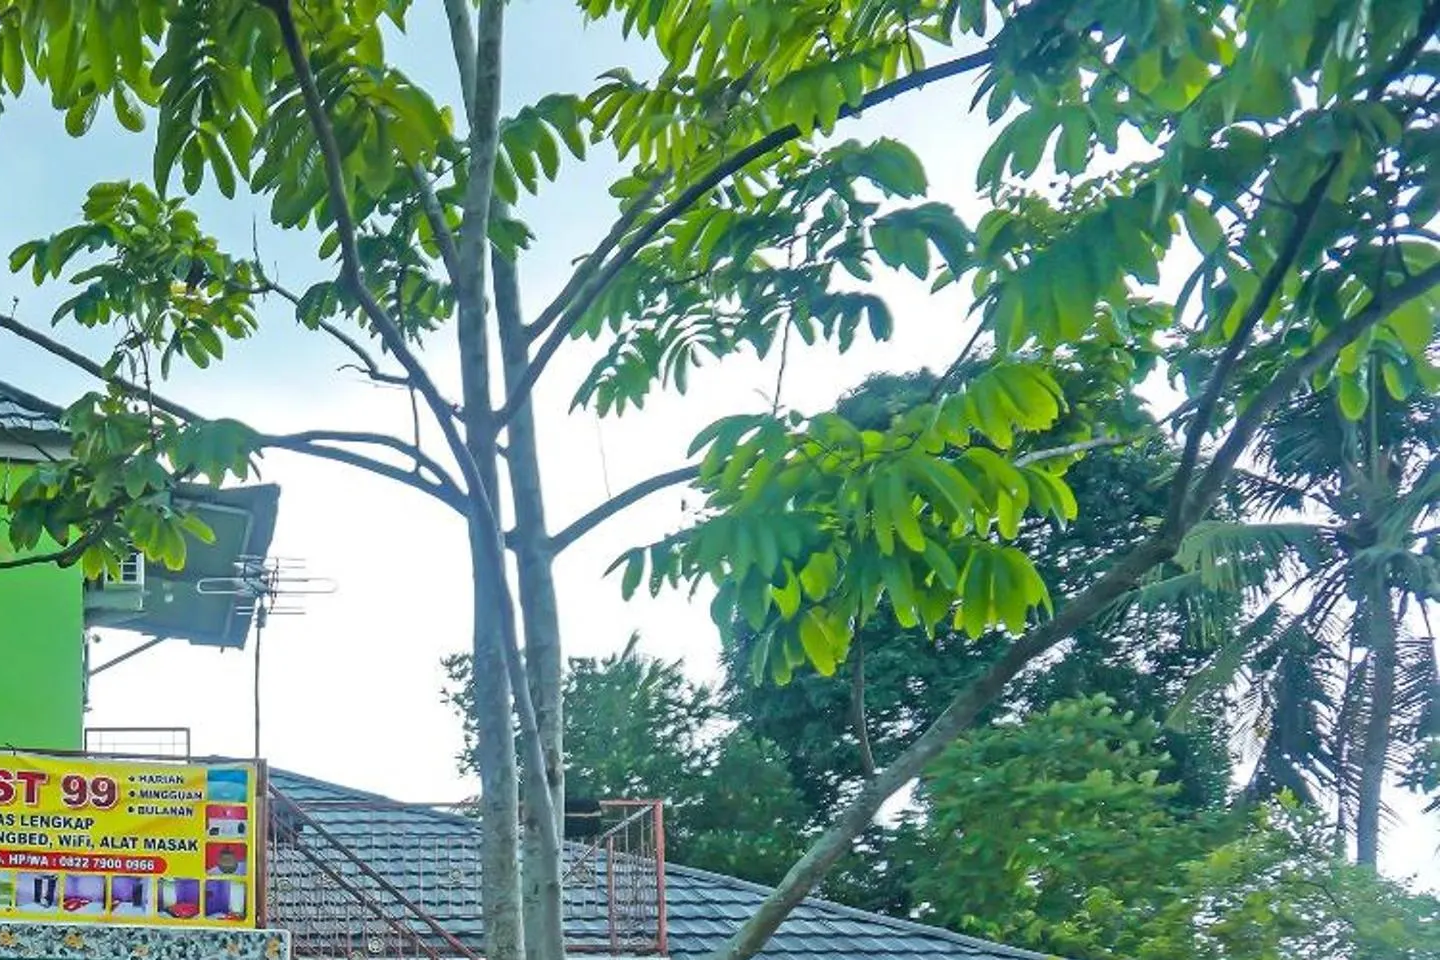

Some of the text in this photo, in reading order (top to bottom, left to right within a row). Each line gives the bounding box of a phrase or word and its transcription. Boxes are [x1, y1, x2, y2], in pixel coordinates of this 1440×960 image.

[138, 775, 184, 784] HARIAN
[61, 774, 119, 809] 99
[139, 789, 203, 800] MINGGUAN
[137, 805, 194, 816] BULANAN
[20, 815, 94, 830] LENGKAP
[99, 837, 138, 850] ALAT
[143, 838, 198, 852] MASAK
[9, 854, 49, 867] HP/WA
[93, 857, 121, 870] 7900
